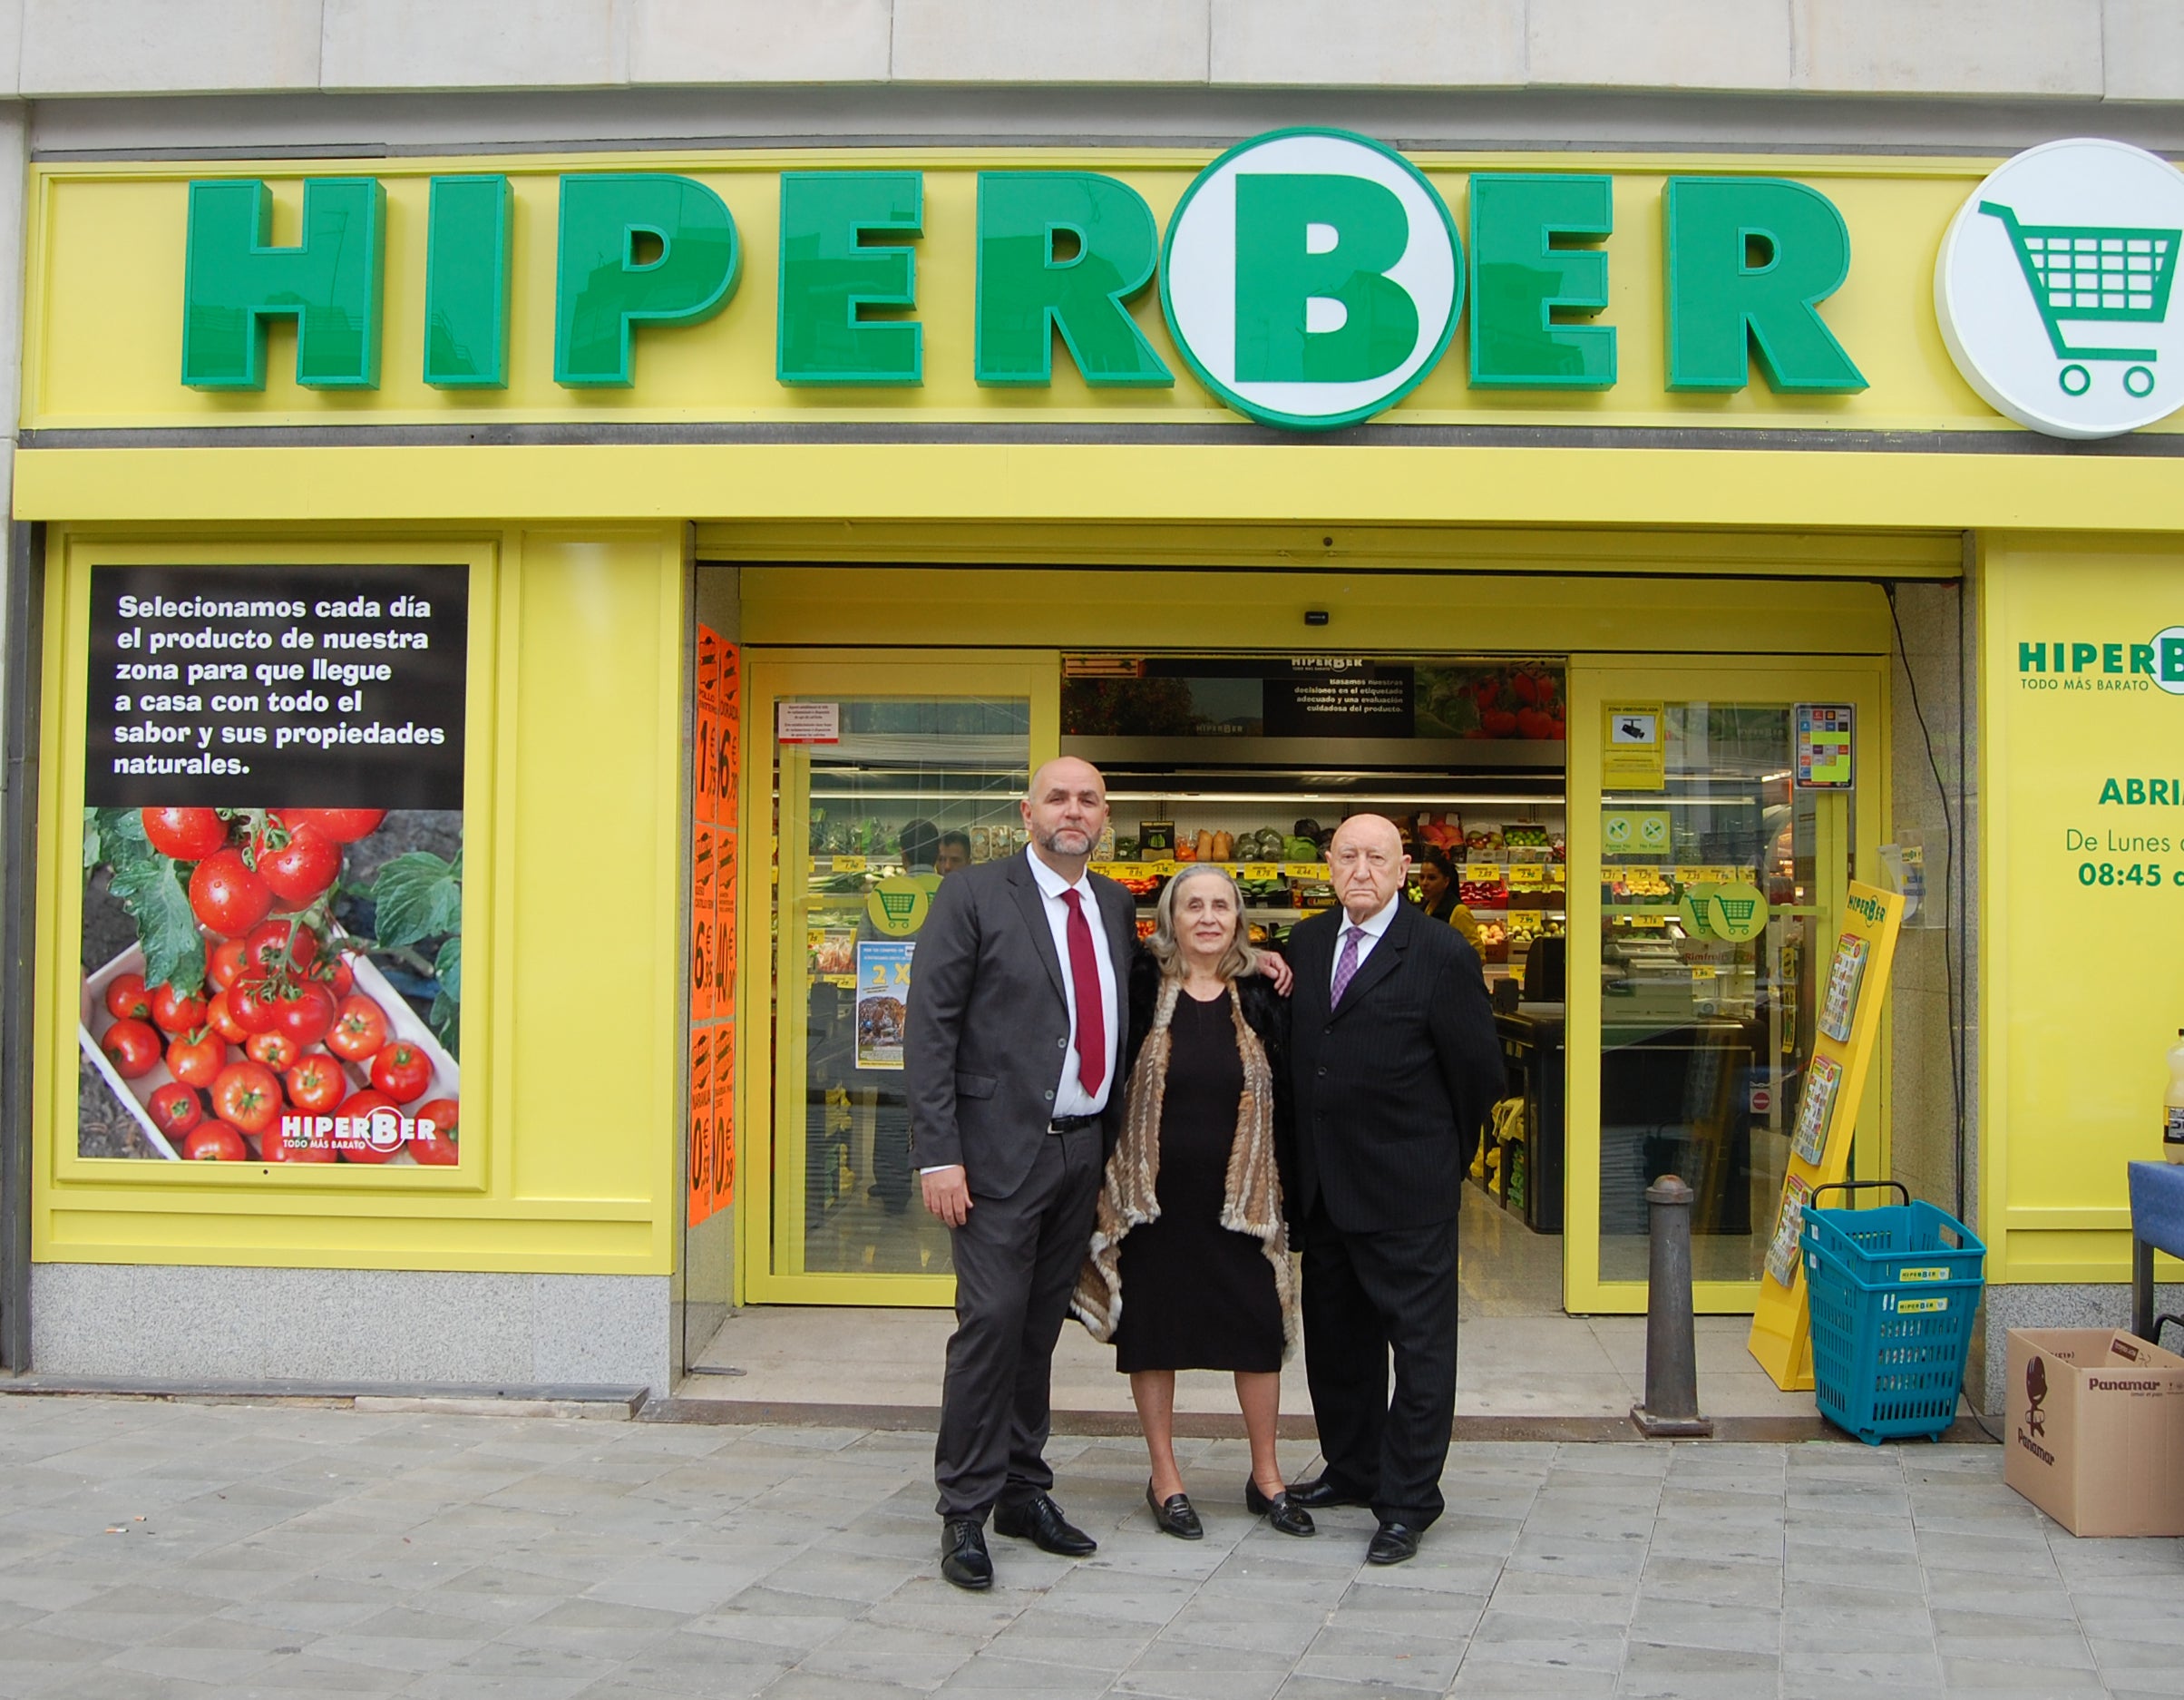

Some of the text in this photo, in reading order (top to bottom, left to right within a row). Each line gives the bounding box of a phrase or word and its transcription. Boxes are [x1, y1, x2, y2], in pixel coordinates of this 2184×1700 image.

[181, 171, 1870, 392] HIPERBER
[118, 595, 431, 618] Selecionamos cada día
[117, 626, 429, 655] el producto de nuestra
[115, 658, 392, 687] zona para que llegue
[2021, 677, 2149, 691] TODO MÁS BARATO
[114, 689, 363, 713] a casa con todo el
[1294, 686, 1337, 694] decisiones
[1360, 687, 1403, 696] etiquetado
[1296, 695, 1336, 703] adecuado
[1306, 704, 1348, 712] cuidadosa
[1349, 704, 1362, 712] del
[114, 720, 445, 749] sabor y sus propiedades
[113, 752, 250, 775] naturales.
[2098, 778, 2184, 806] ABRI
[2066, 828, 2098, 852] De
[2108, 828, 2170, 852] Lunes
[2078, 862, 2161, 886] 08:45
[1847, 894, 1887, 923] HIPERBER
[872, 964, 886, 985] 2
[282, 1113, 437, 1145] HIPERBER
[283, 1138, 366, 1150] TODO MÁS BARATO
[2089, 1377, 2160, 1392] Panamar
[2017, 1427, 2055, 1467] Panamar
